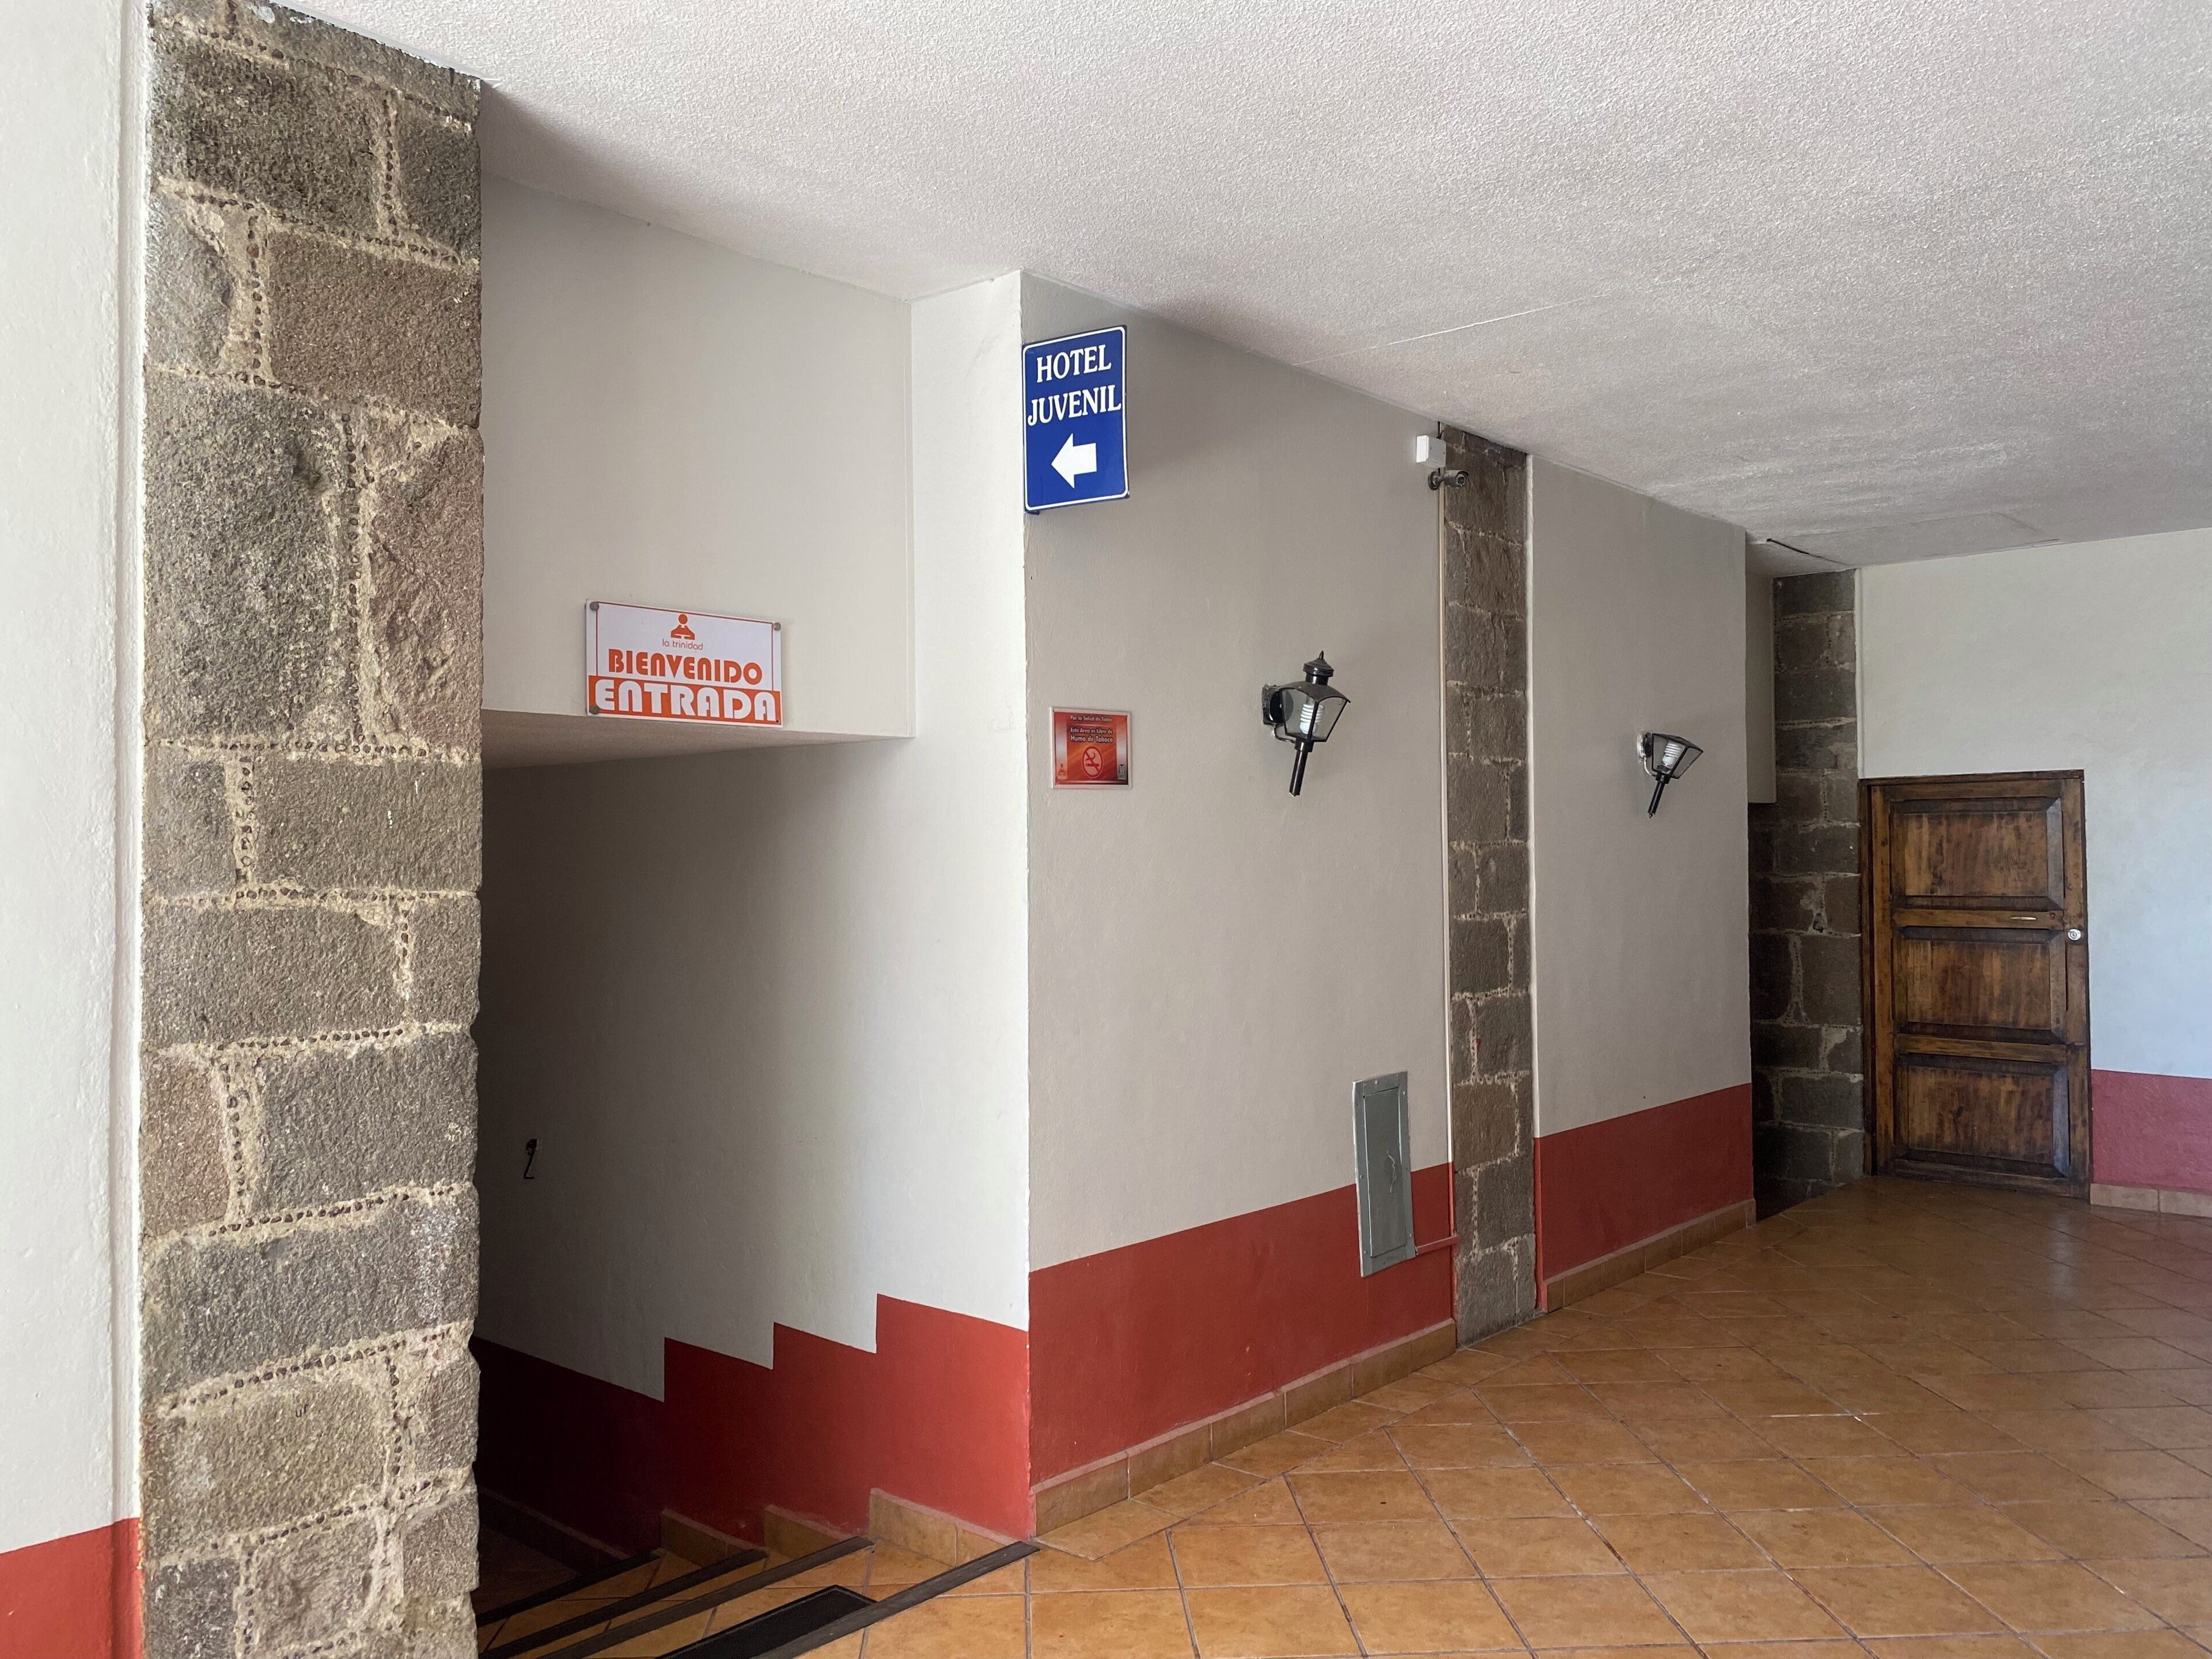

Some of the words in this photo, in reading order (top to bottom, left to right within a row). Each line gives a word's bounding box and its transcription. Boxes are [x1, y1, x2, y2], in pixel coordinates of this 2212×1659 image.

[1037, 344, 1112, 382] HOTEL
[1028, 385, 1122, 426] JUVENIL
[662, 638, 670, 647] la
[673, 640, 703, 650] trinidad
[608, 648, 763, 685] BIENVENIDO
[595, 679, 776, 721] ENTRADA
